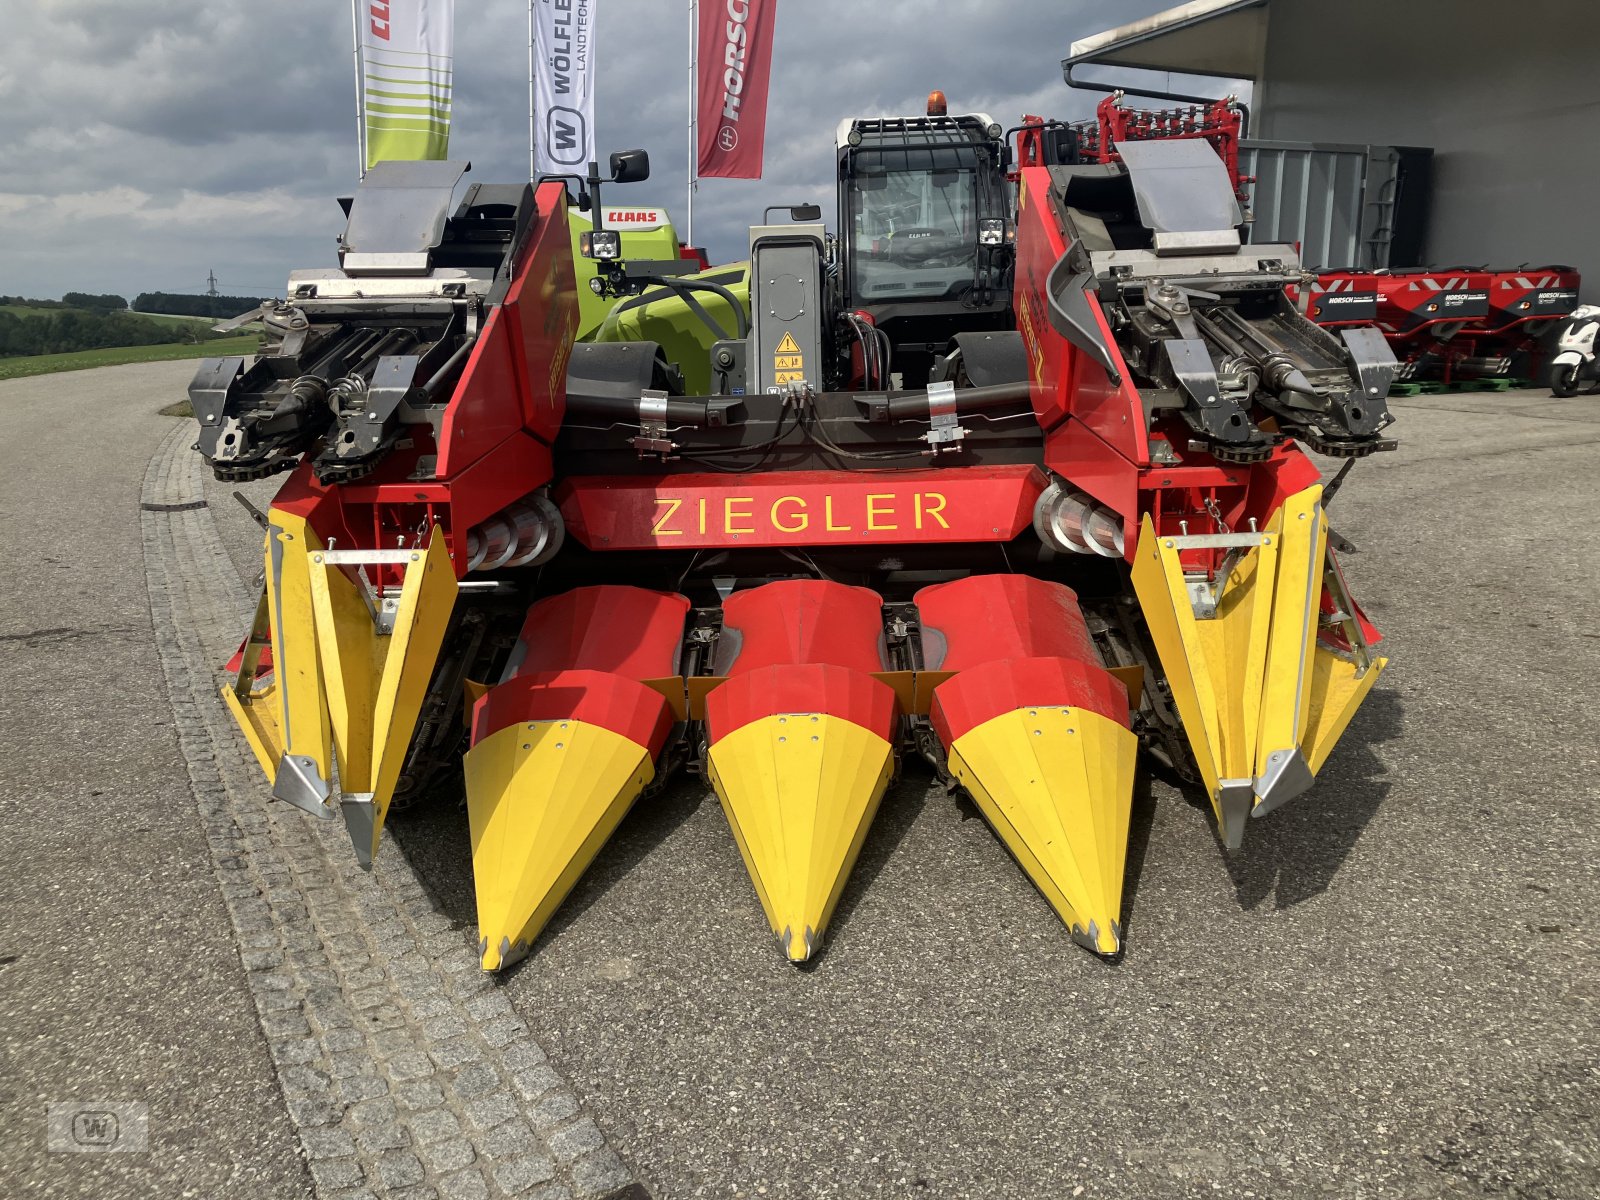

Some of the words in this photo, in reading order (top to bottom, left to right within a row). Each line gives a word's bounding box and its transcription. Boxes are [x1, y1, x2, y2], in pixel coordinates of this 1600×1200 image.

[370, 0, 390, 41] CL
[555, 119, 577, 150] W
[608, 211, 657, 222] CLAAS
[1328, 296, 1354, 304] HORSCH
[650, 492, 951, 535] ZIEGLER
